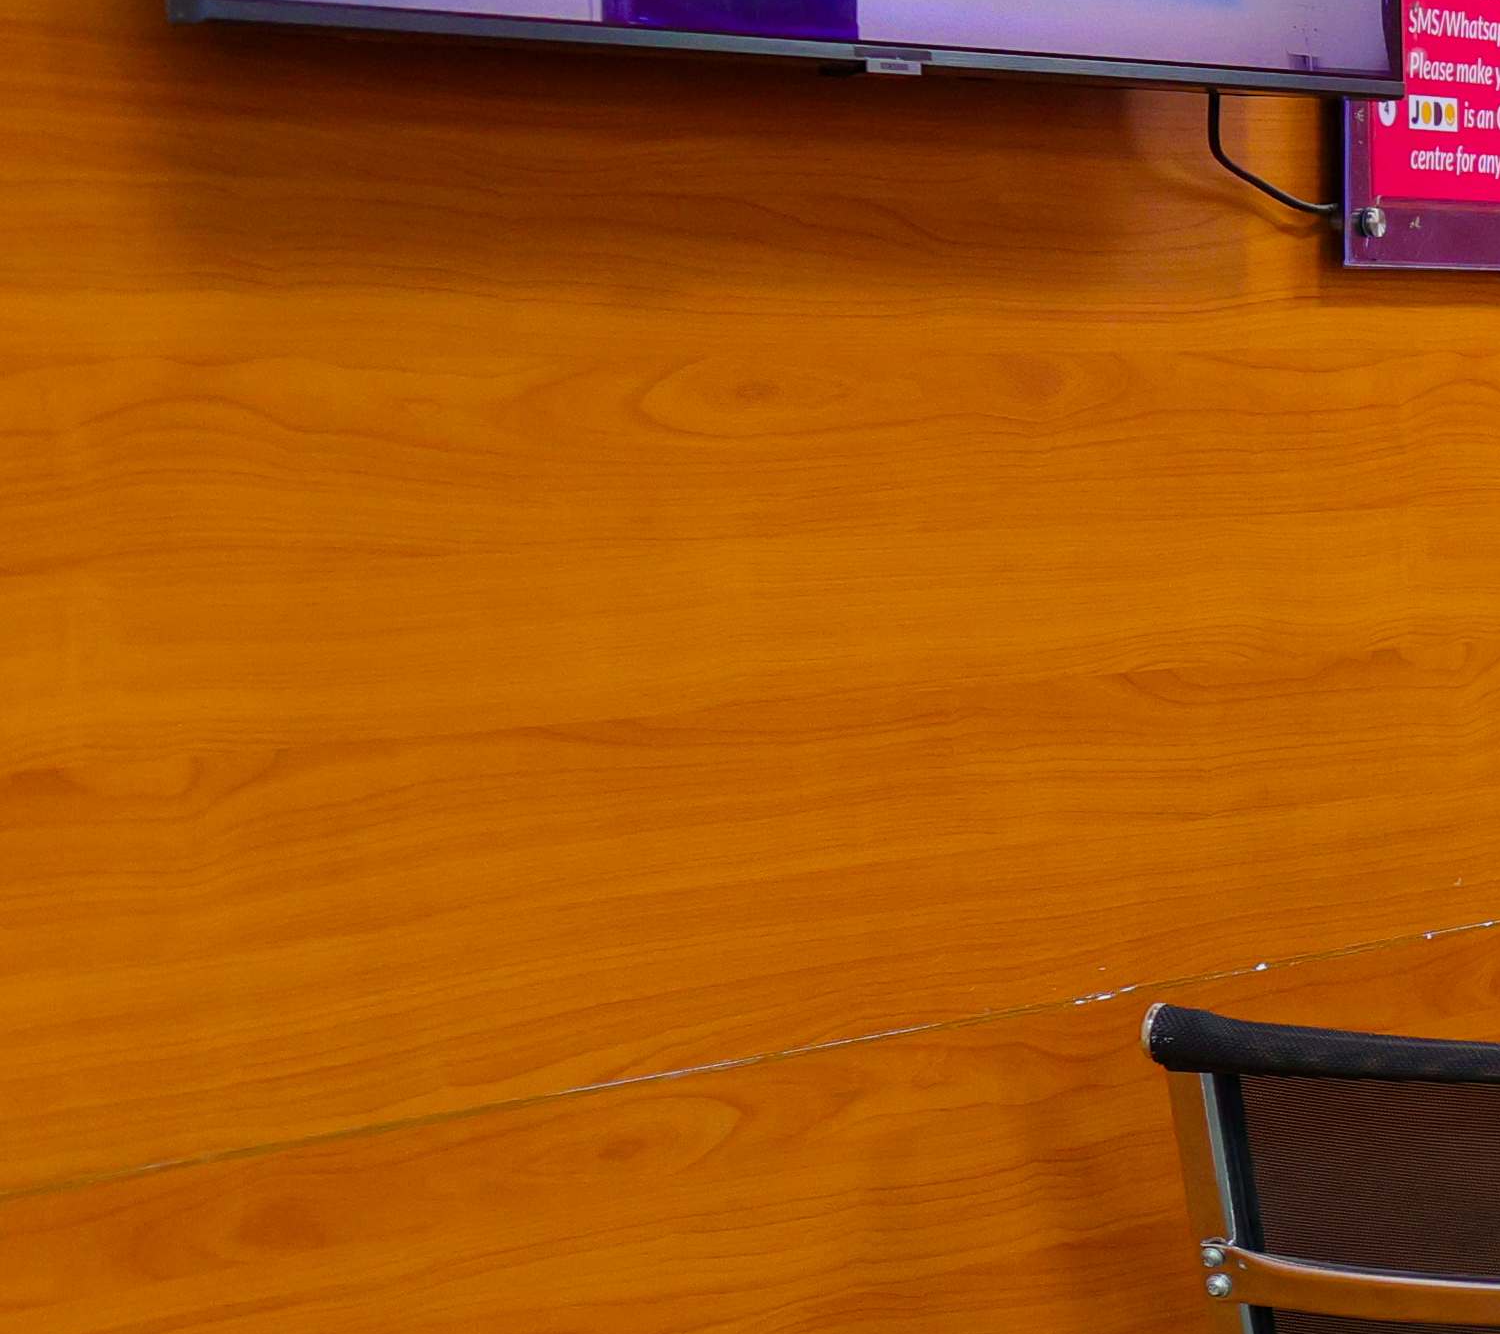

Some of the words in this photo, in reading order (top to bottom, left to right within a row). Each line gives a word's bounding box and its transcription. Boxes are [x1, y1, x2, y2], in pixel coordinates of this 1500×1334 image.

[1409, 51, 1455, 82] Please
[1455, 57, 1494, 86] make
[1463, 108, 1476, 129] is
[1476, 109, 1495, 130] an
[1410, 146, 1455, 172] centre
[1455, 146, 1477, 176] for
